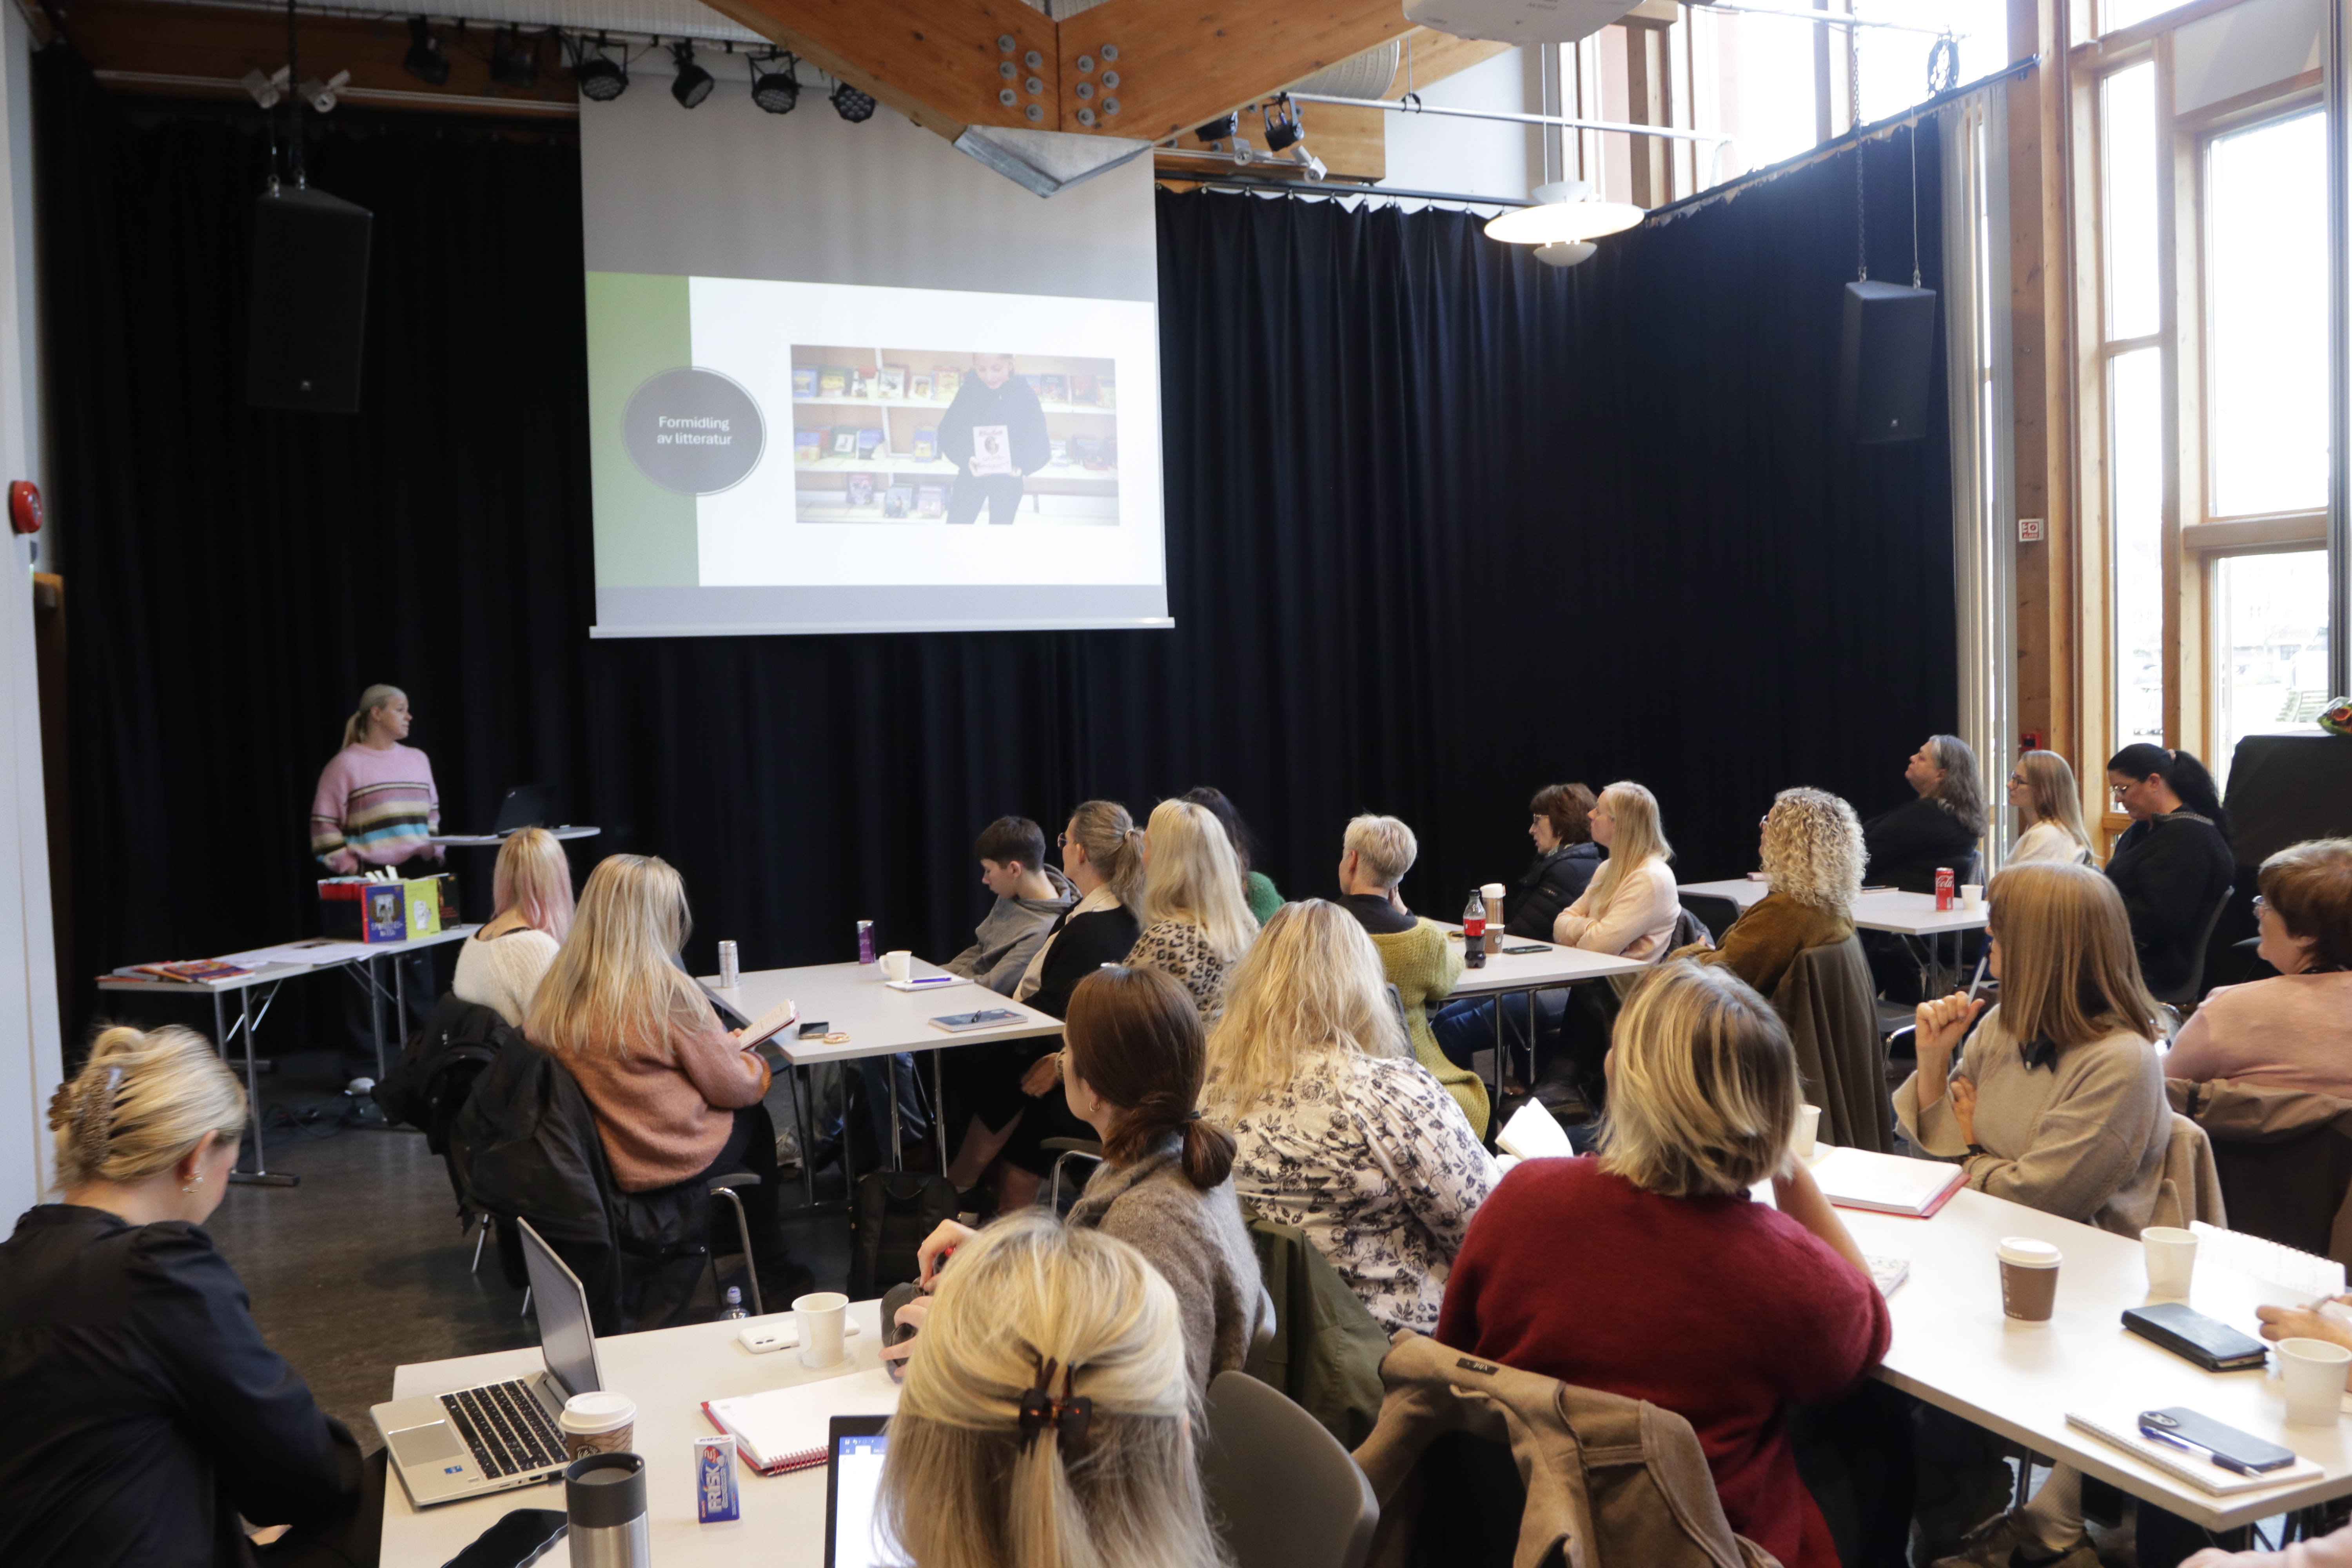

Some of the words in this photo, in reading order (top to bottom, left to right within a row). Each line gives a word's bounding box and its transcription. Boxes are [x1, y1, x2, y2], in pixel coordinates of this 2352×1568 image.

[659, 416, 730, 432] Formidling
[657, 434, 673, 444] av
[675, 432, 732, 445] litteratur
[706, 1465, 722, 1513] FRISK
